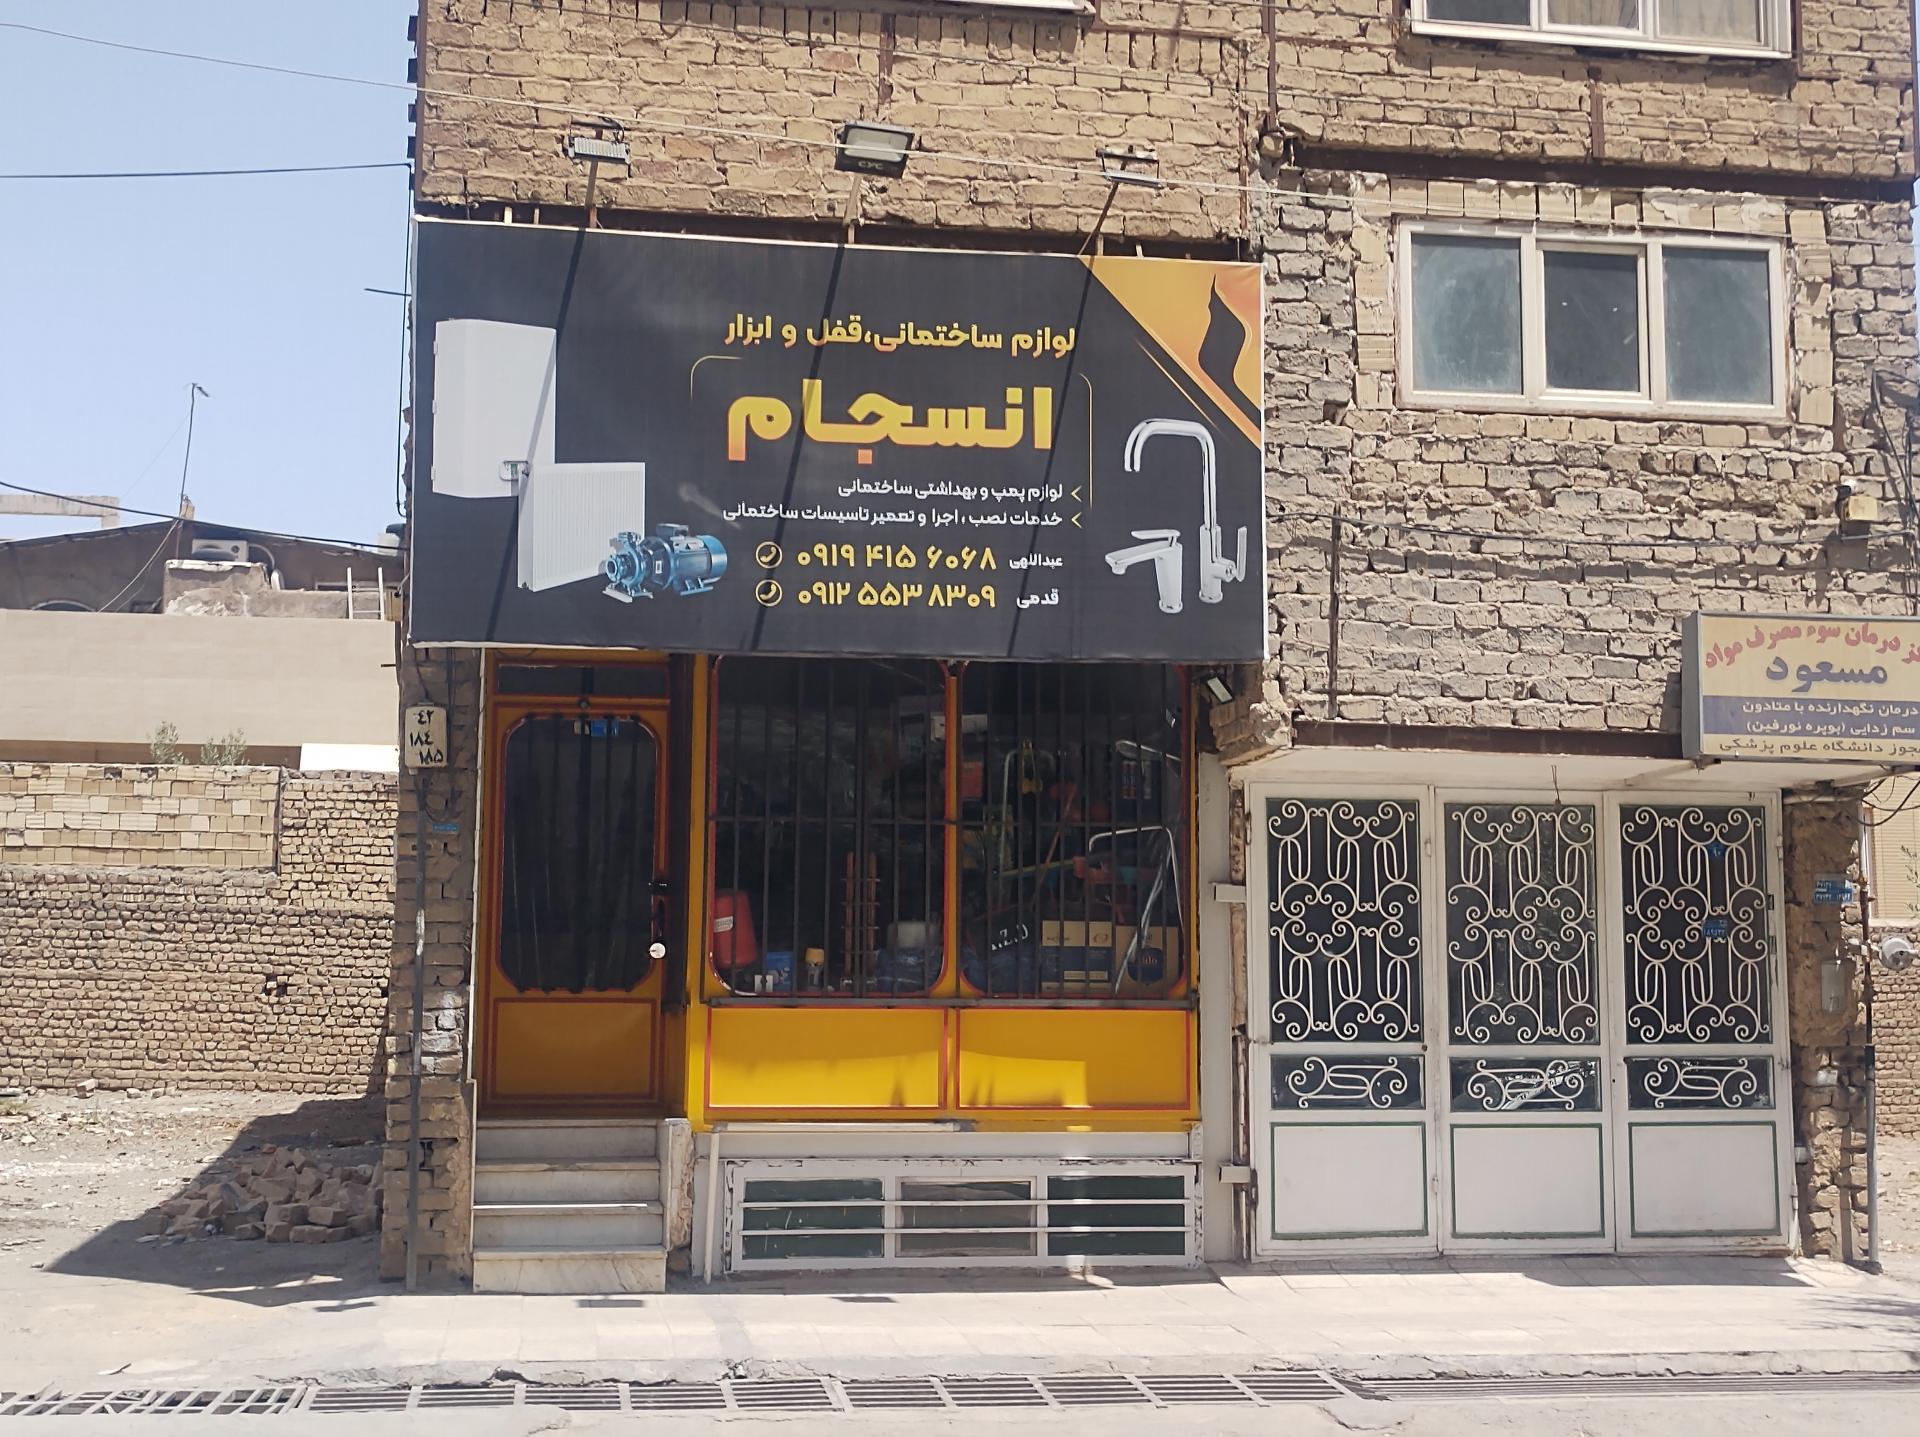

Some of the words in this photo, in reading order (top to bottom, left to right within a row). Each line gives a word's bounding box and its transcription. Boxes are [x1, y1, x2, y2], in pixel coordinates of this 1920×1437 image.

[724, 313, 772, 346] ابزار
[781, 324, 797, 348] و
[1011, 327, 1075, 358] لوازم
[727, 378, 1053, 465] انسجام
[838, 477, 913, 497] ساختمانی
[915, 480, 977, 500] بهداشتی
[980, 486, 989, 500] و
[991, 485, 1025, 503] پمپ
[1027, 483, 1063, 502] لوازم
[723, 501, 799, 521] ساختمانی
[801, 504, 870, 525] تاسیسات
[870, 508, 915, 526] تعمیر
[917, 513, 927, 527] و
[931, 508, 958, 527] اجرا
[1009, 510, 1063, 526] خدمات
[797, 543, 855, 567] ۰۹۱۹
[866, 544, 917, 568] ۴۱۵
[926, 545, 997, 570] ۶۰۶۸
[1009, 553, 1064, 570] عبداللهی
[798, 581, 851, 605] ۰۹۱۲
[857, 581, 923, 606] ۵۵۳
[928, 584, 996, 608] ۸۳۰۹
[1016, 588, 1060, 609] قدمی
[1746, 624, 1802, 650] مصرف
[1844, 622, 1901, 654] درمان
[1705, 641, 1743, 669] مواد
[1766, 655, 1888, 693] مسعود
[1742, 700, 1791, 713] متادون
[1794, 701, 1804, 714] با
[1808, 702, 1874, 716] نگهدارنده
[1878, 704, 1919, 717] درمان
[1850, 722, 1888, 736] زدایی
[1892, 725, 1916, 737] سم
[1719, 738, 1774, 754] پزشکی
[1780, 740, 1818, 754] علوم
[1822, 740, 1883, 752] دانشگاه
